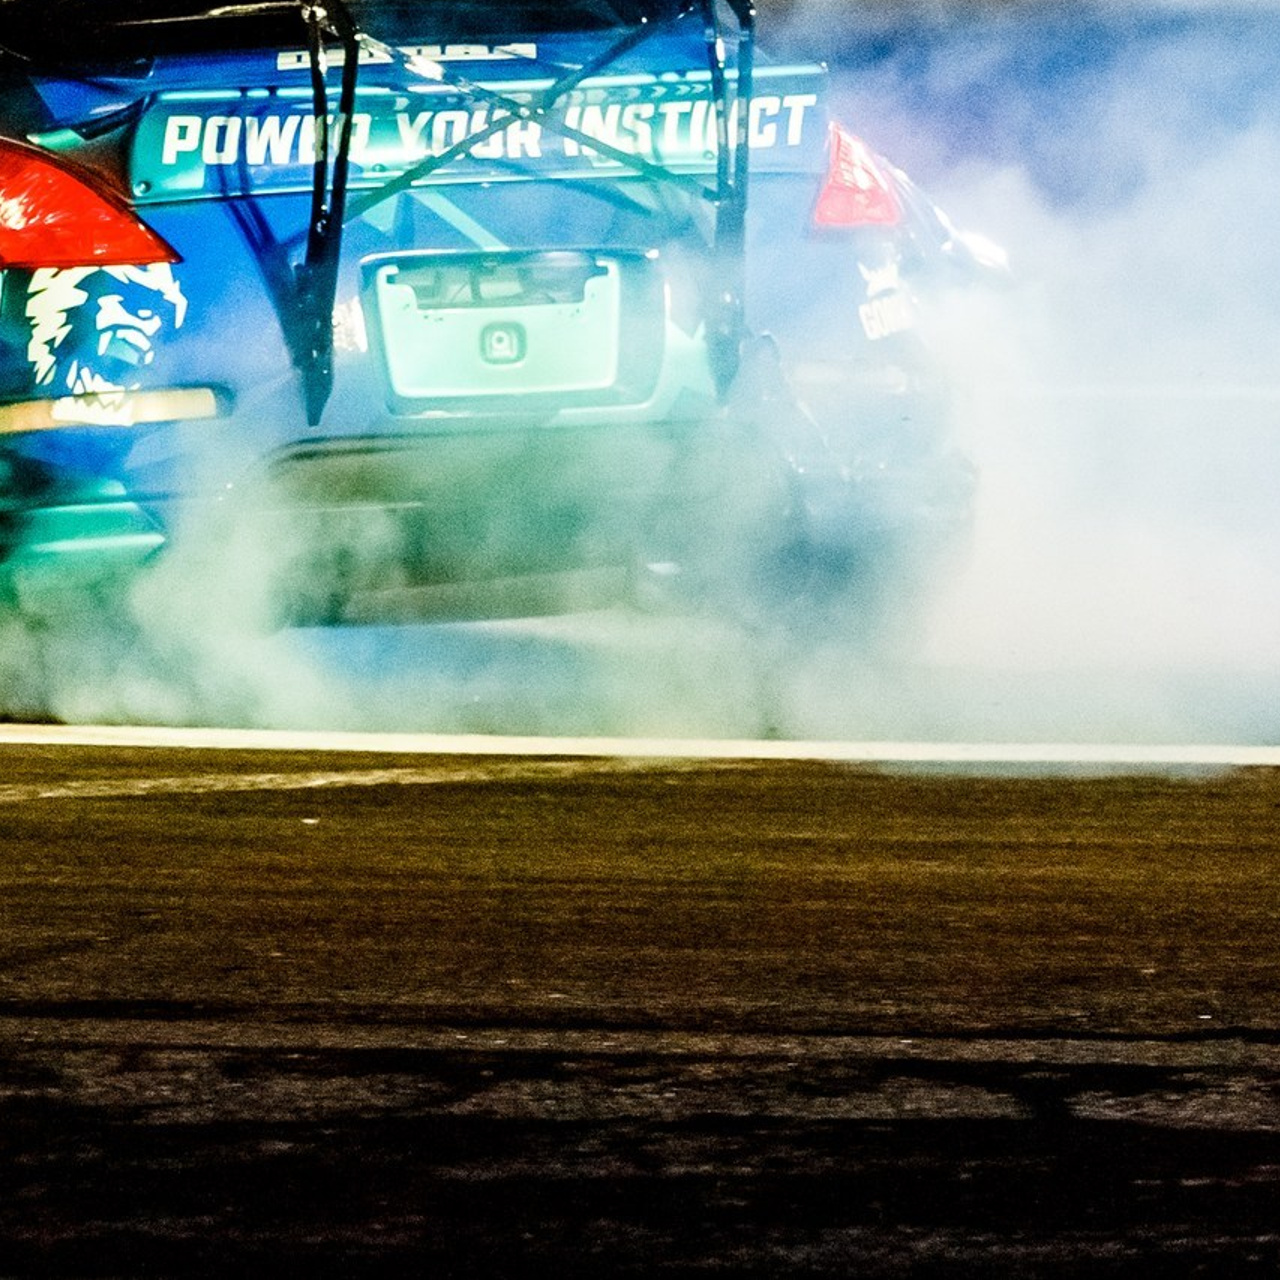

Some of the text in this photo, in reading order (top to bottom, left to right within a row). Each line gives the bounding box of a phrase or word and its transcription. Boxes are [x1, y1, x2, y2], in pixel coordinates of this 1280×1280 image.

[162, 94, 817, 165] POWER YOUR INSTINCT
